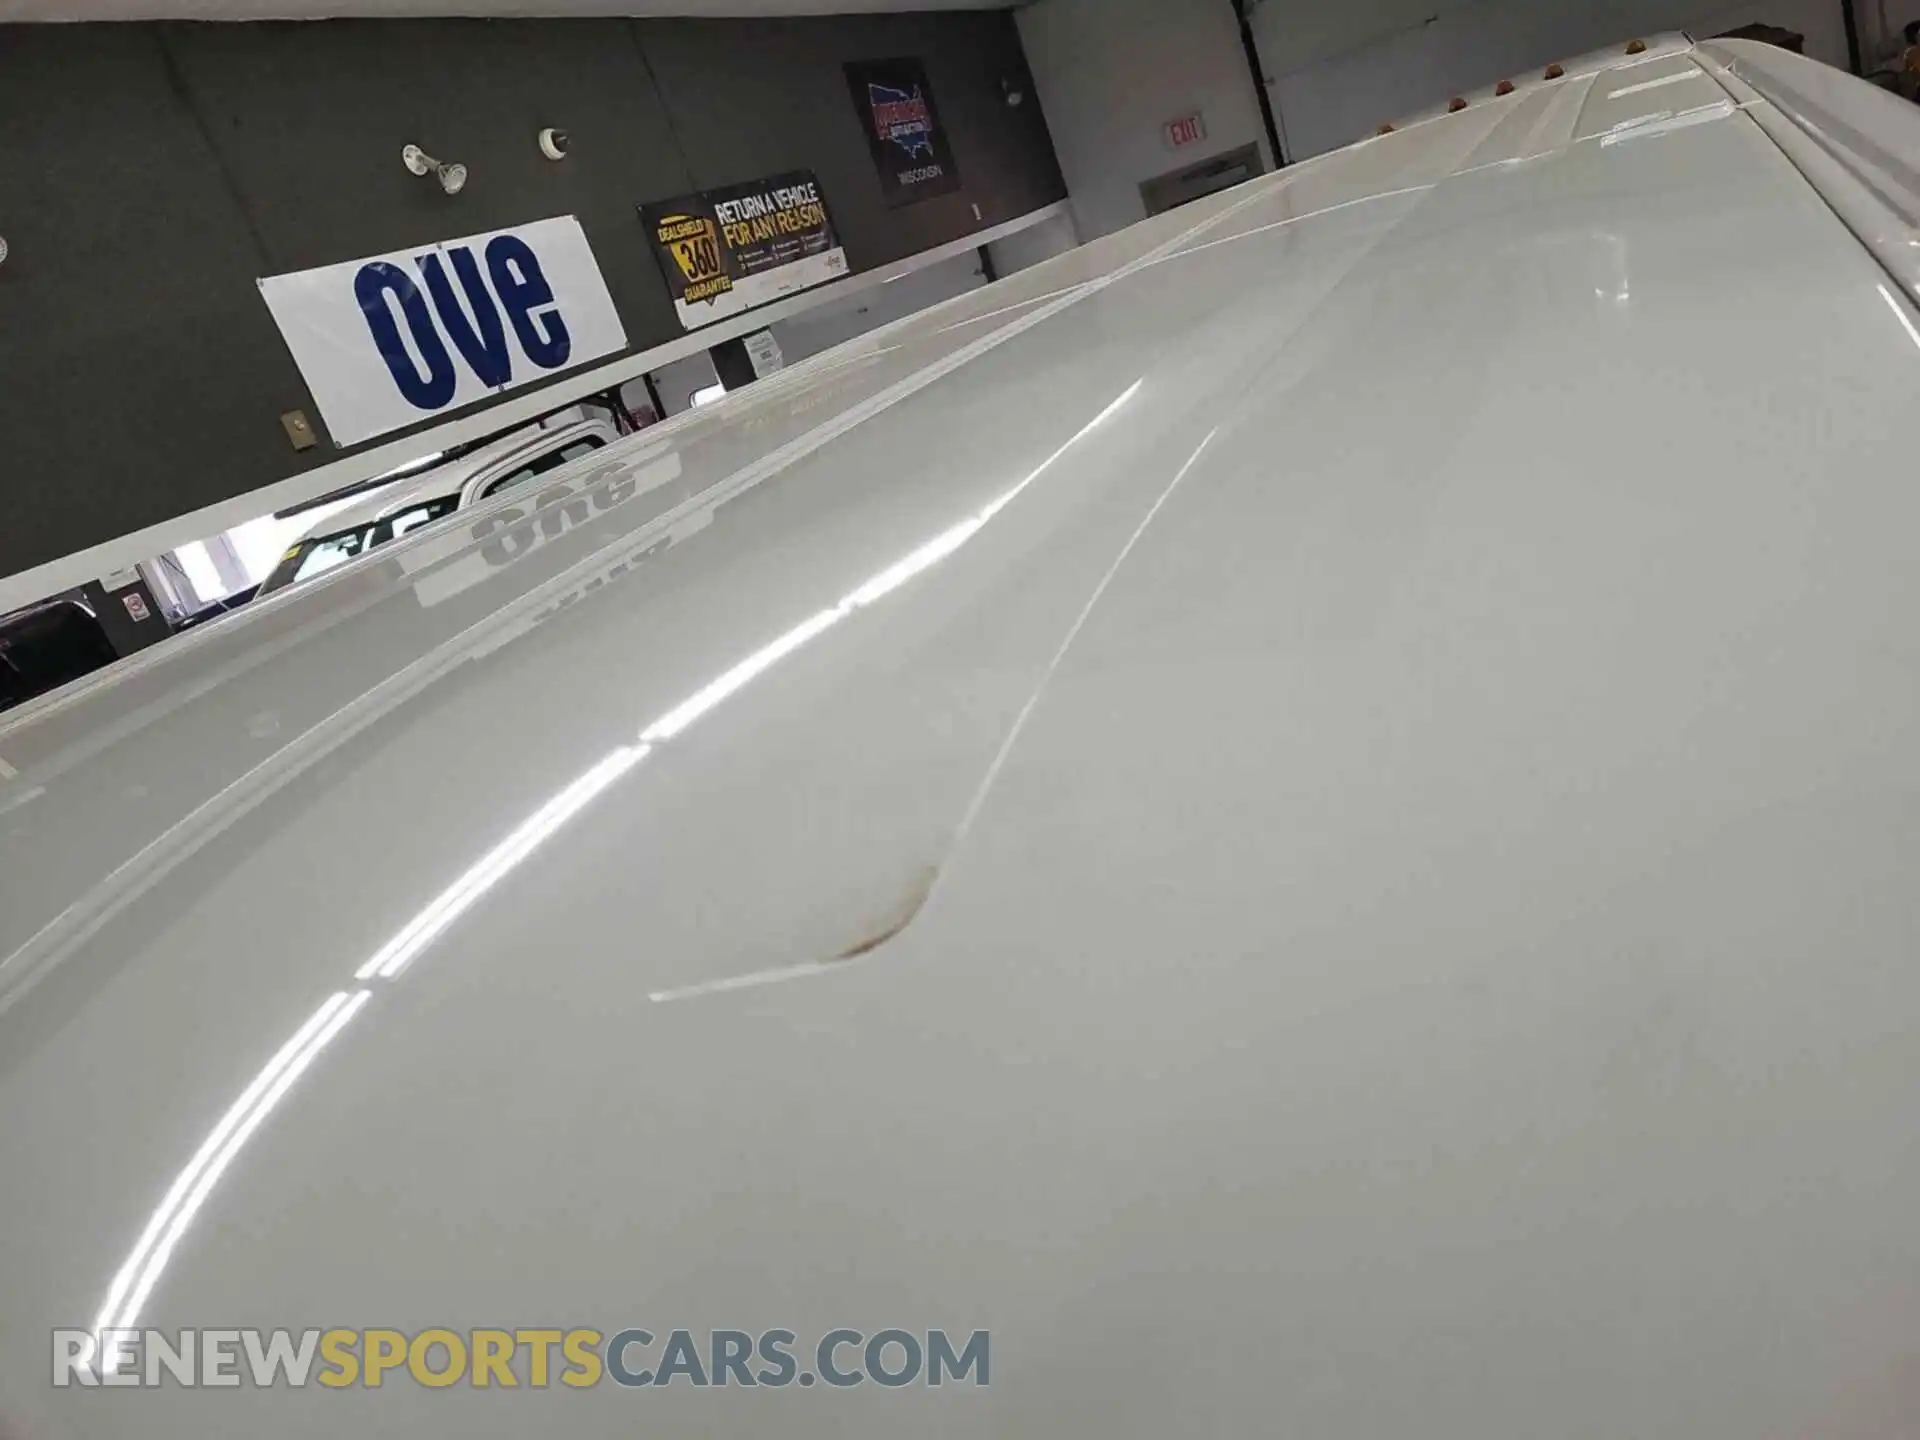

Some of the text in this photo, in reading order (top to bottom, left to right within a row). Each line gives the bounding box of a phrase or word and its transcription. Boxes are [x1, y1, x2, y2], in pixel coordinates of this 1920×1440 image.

[1170, 117, 1199, 146] EXIT
[714, 182, 819, 226] RETURN A VEHICLE
[657, 219, 705, 242] DEALSHIELD
[722, 221, 754, 249] FOR
[751, 214, 778, 243] ANY
[775, 202, 827, 234] REASON
